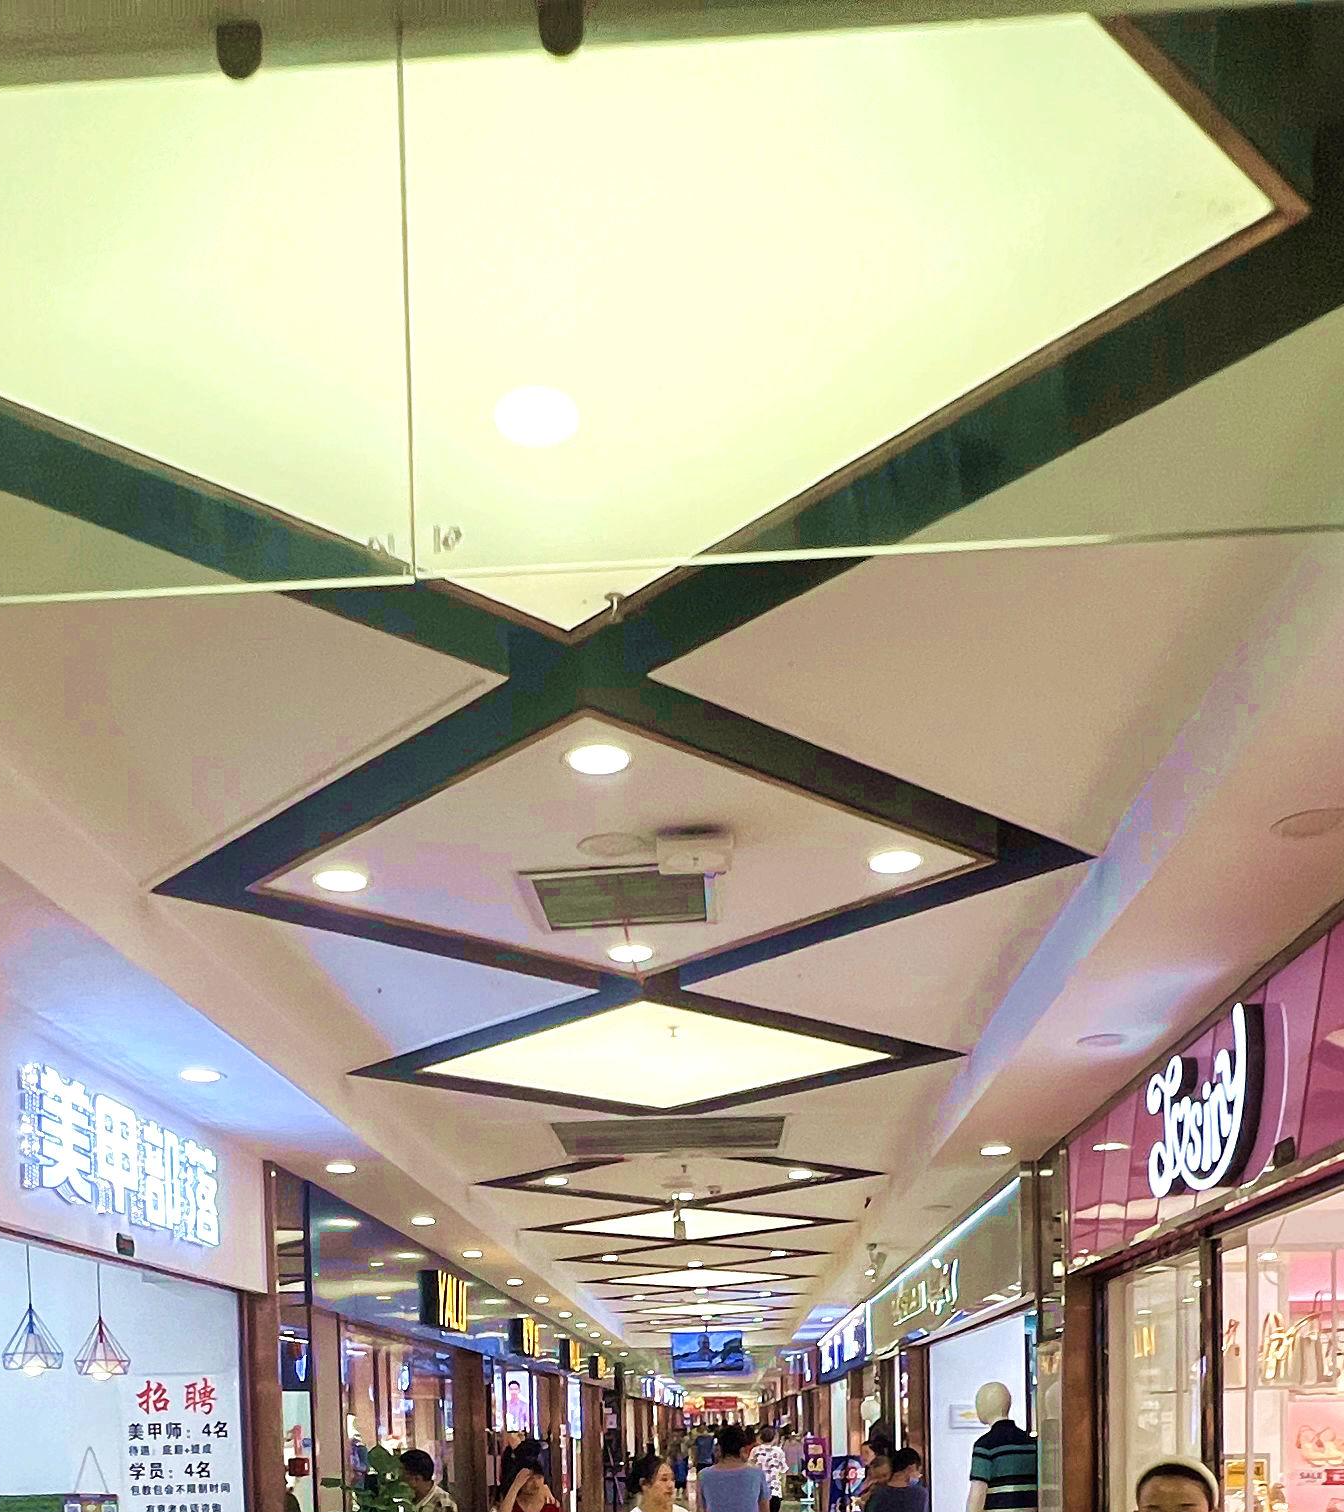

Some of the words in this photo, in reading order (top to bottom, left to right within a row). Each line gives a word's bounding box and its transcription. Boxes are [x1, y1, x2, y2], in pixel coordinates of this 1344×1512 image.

[20, 1062, 220, 1248] 美甲部落
[136, 1377, 218, 1415] 招聘
[202, 1420, 228, 1439] 4名
[184, 1461, 211, 1479] 4名
